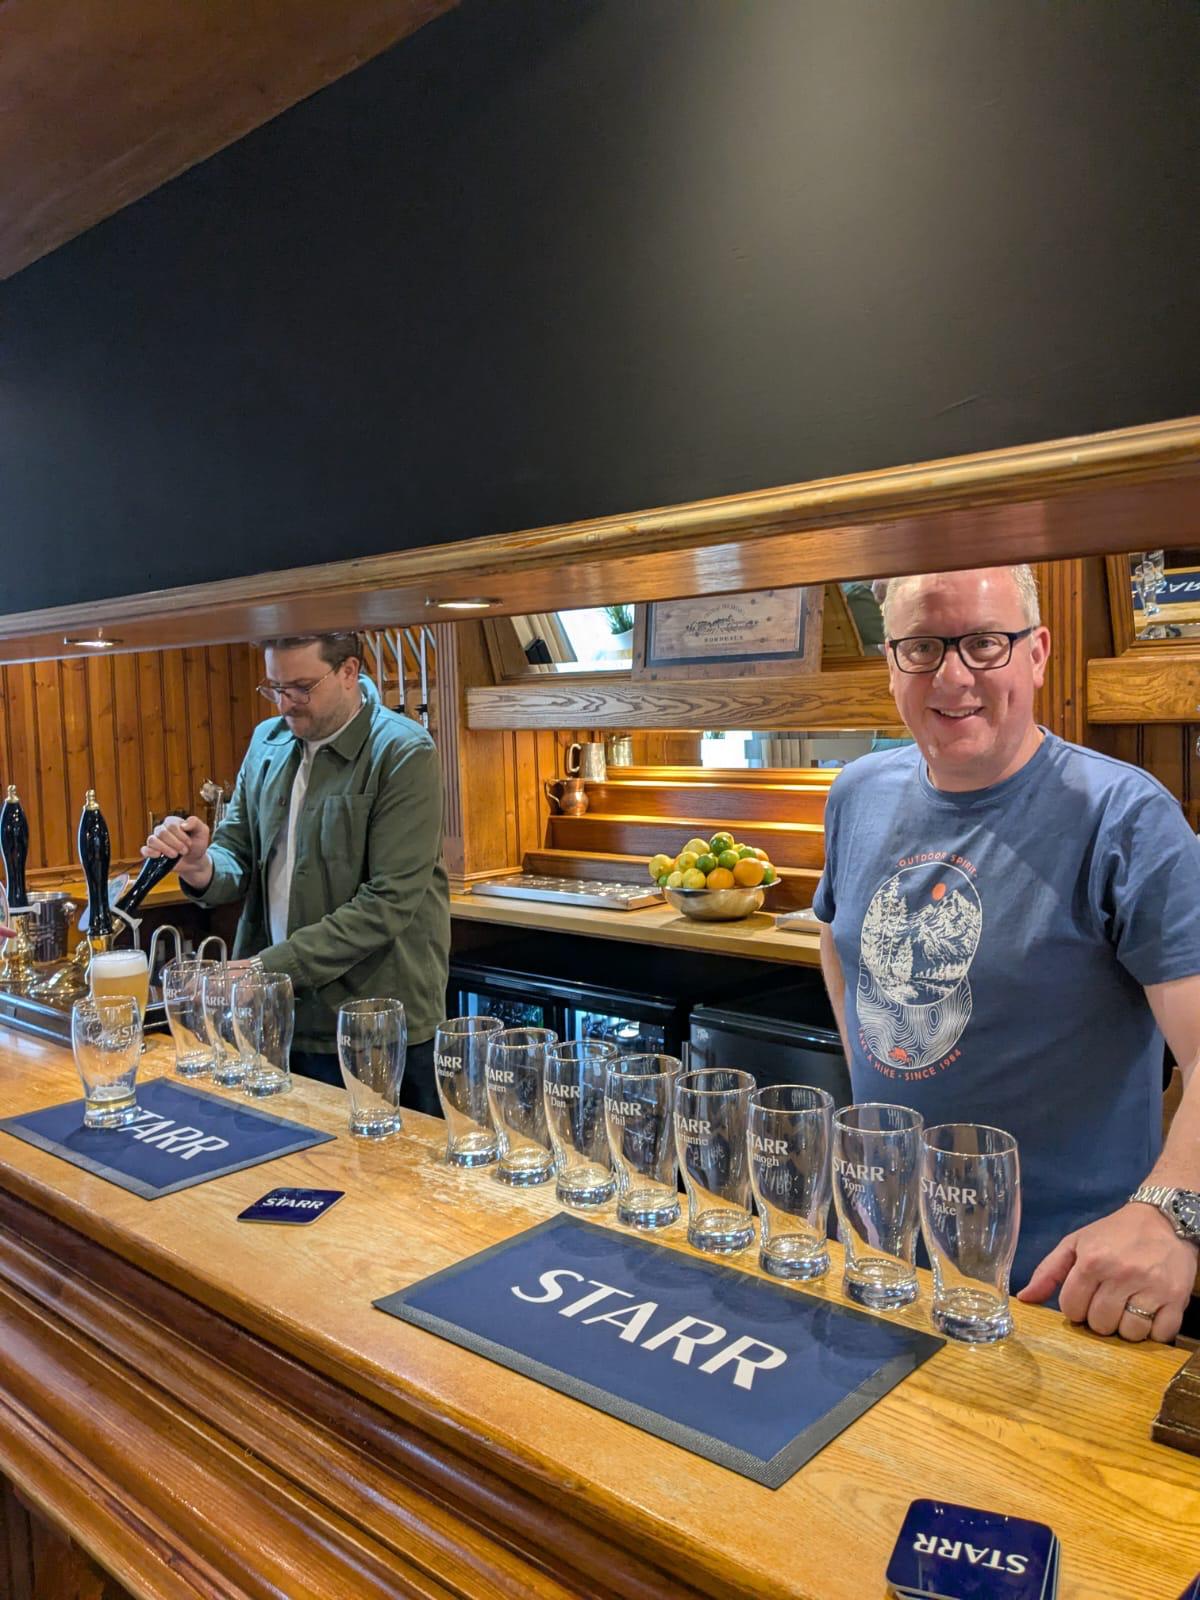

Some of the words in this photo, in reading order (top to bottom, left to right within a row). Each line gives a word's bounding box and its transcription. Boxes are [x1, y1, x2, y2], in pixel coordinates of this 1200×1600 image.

[898, 852, 948, 867] OUTDOOR
[951, 854, 977, 874] SPIRIT
[873, 1061, 897, 1079] HIKE
[904, 1066, 937, 1081] SINCE
[551, 1096, 567, 1109] Dan
[611, 1114, 626, 1127] Phil
[117, 1108, 230, 1161] TARR
[834, 1156, 885, 1183] STARR
[841, 1175, 866, 1194] Tom
[919, 1175, 978, 1206] STARR
[262, 1197, 324, 1209] STARR
[931, 1201, 958, 1217] Jake
[511, 1269, 788, 1391] STARR
[911, 1532, 1030, 1575] STARR
